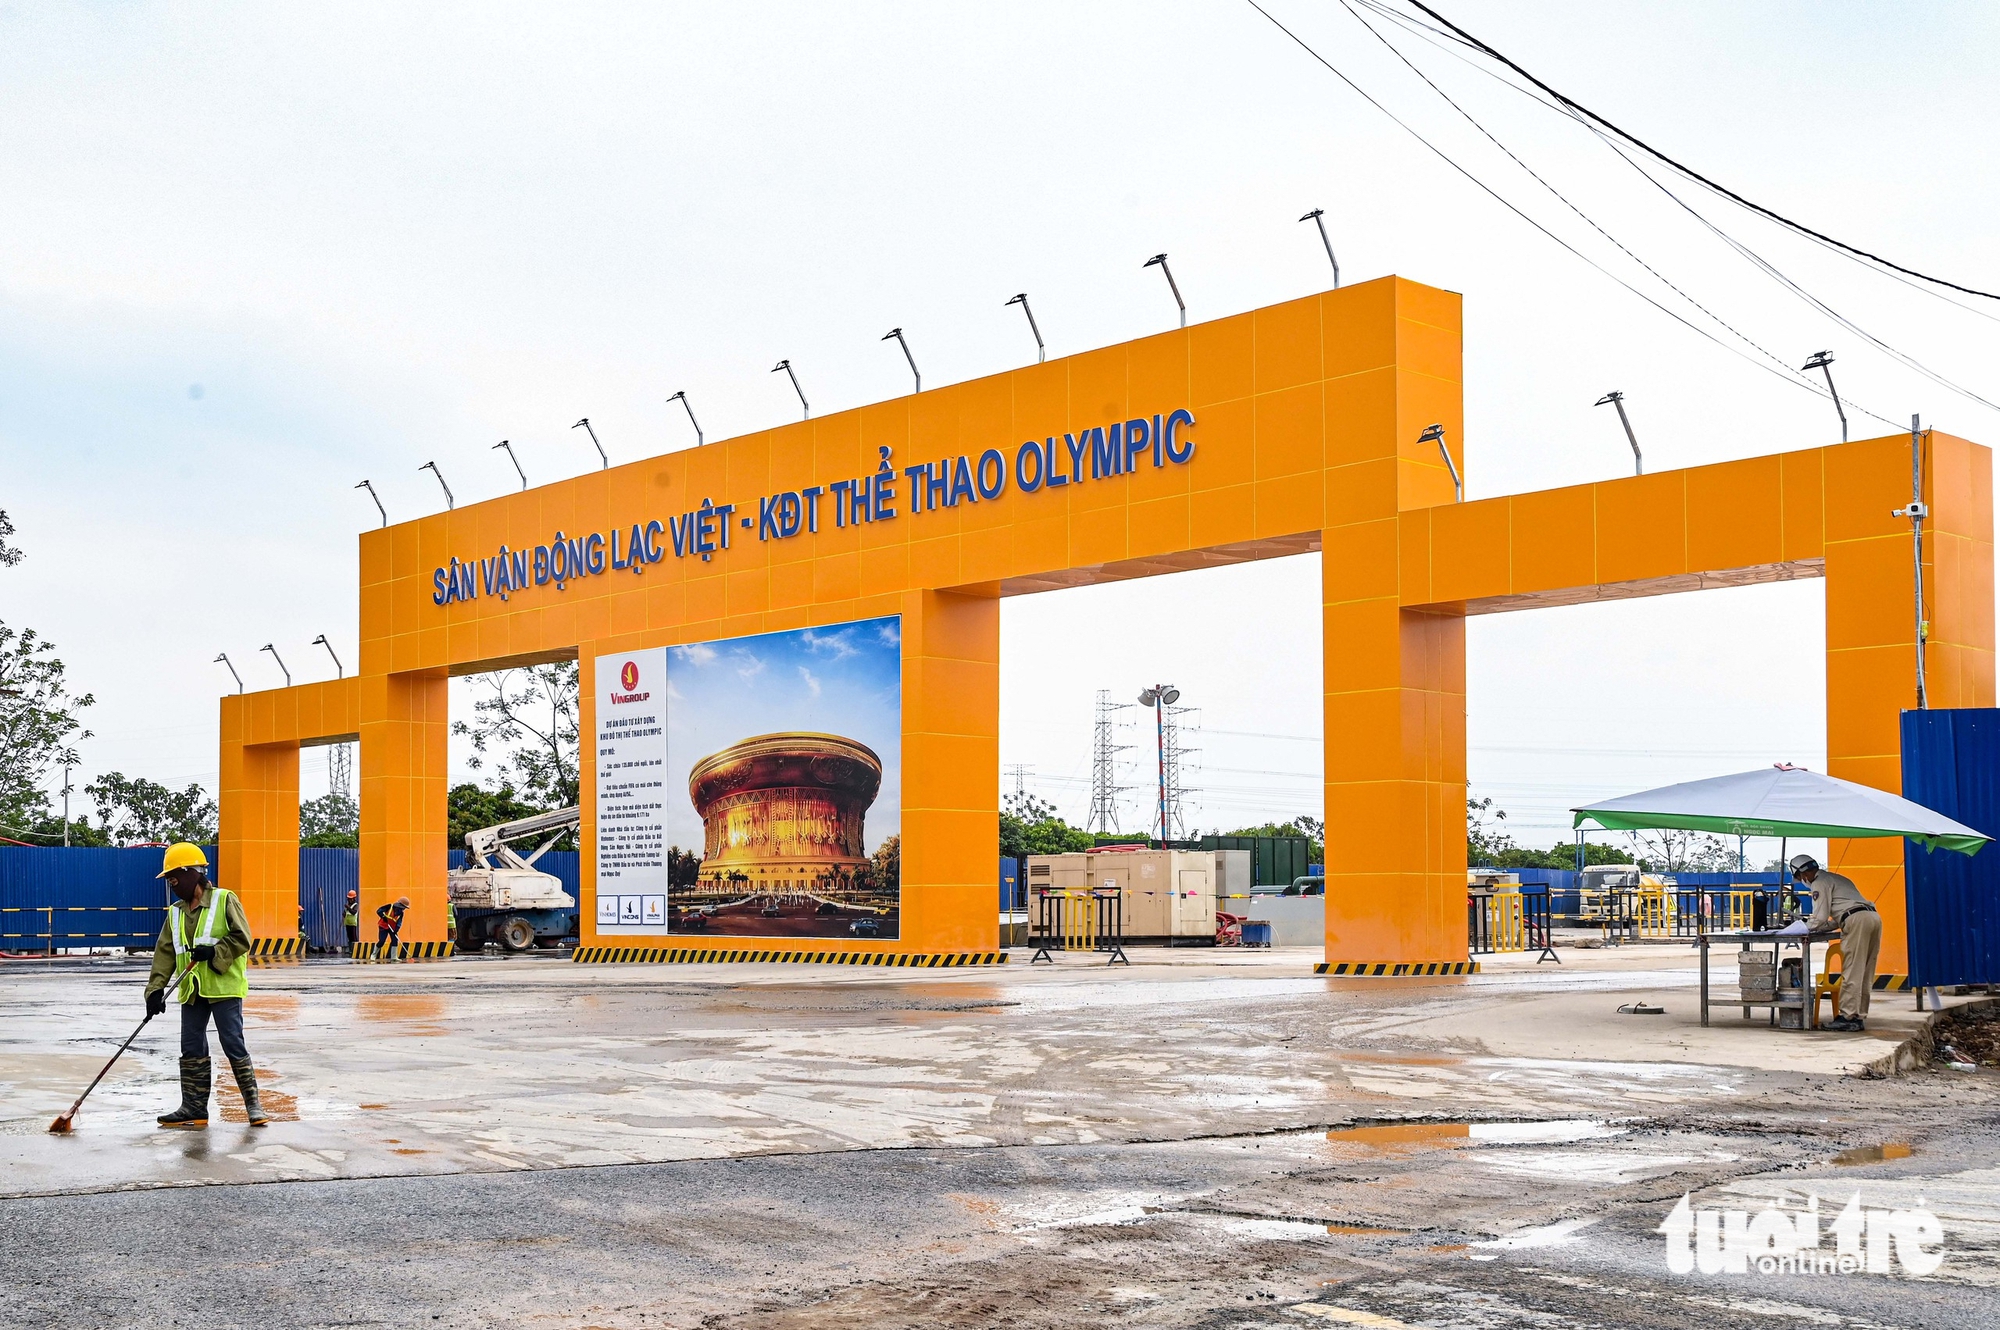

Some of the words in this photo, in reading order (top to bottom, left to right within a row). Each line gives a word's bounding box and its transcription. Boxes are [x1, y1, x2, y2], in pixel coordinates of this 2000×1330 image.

[433, 557, 477, 606] SÂN
[481, 545, 529, 601] VẬN
[533, 531, 606, 591] ĐỘNG
[611, 519, 665, 576] LẠC
[669, 498, 735, 562] VIỆT
[741, 518, 753, 528] -
[759, 487, 823, 541] KĐT
[829, 446, 897, 528] THỂ
[905, 449, 1007, 513] THAO
[1015, 409, 1196, 492] OLYMPIC
[610, 692, 650, 705] VINGROUP
